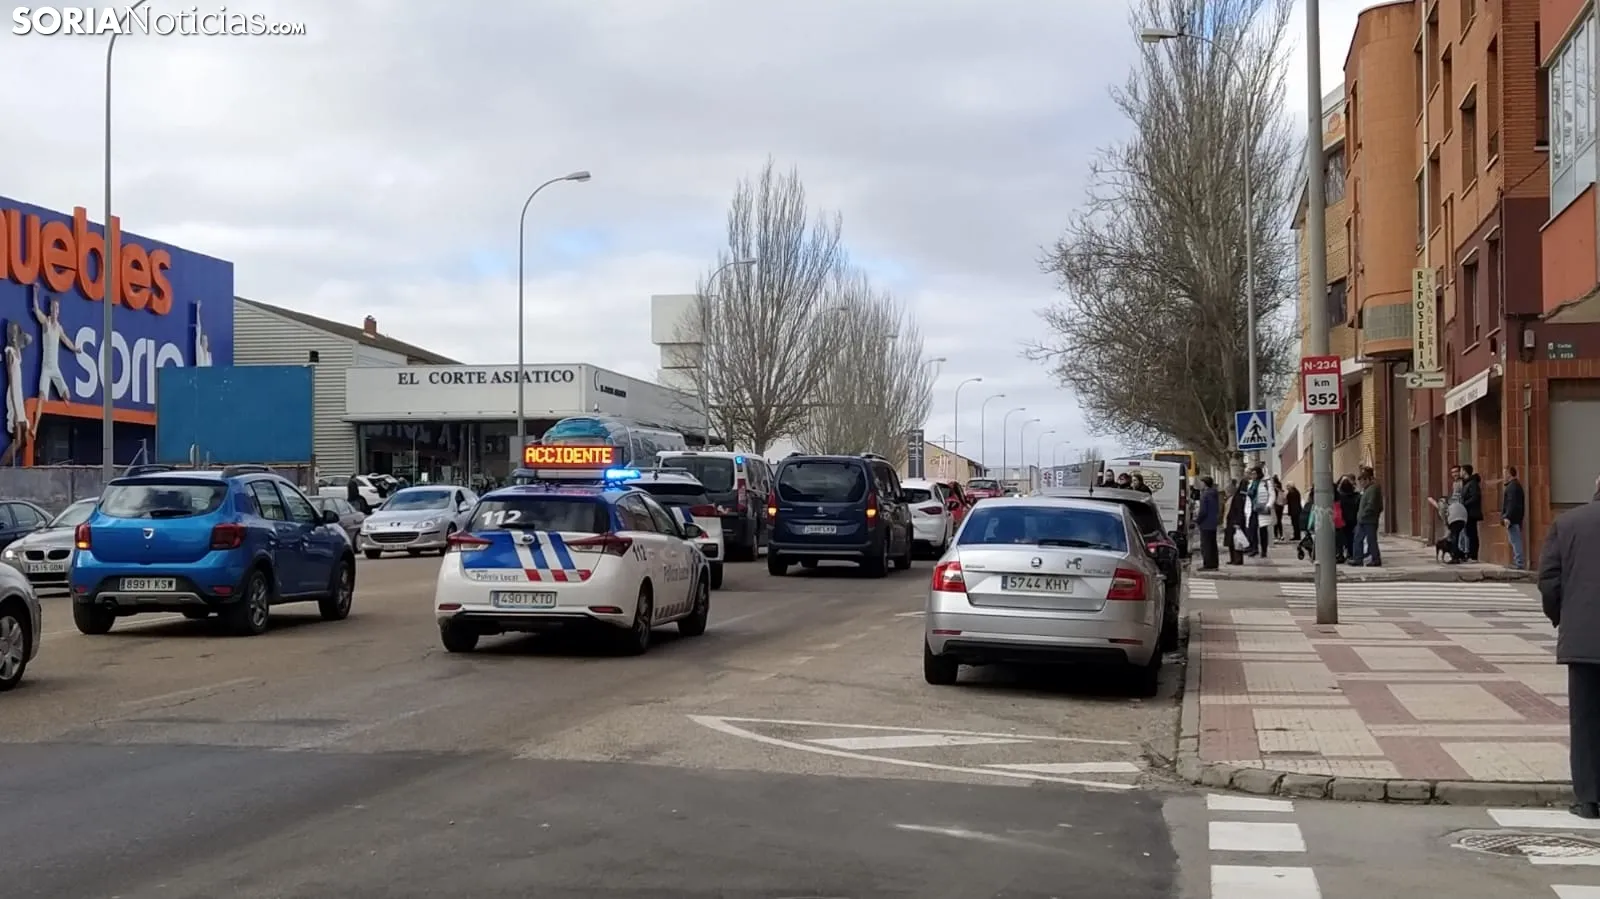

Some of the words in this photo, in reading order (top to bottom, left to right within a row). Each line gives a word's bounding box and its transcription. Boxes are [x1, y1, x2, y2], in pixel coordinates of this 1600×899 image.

[1416, 271, 1425, 370] REPOSTERIA
[1426, 275, 1434, 368] PANADERIA
[1304, 360, 1338, 370] N-234
[398, 372, 420, 385] EL
[428, 371, 487, 384] CORTE
[490, 369, 574, 384] ASIATICO
[1314, 378, 1330, 387] km
[1308, 392, 1338, 406] 352
[525, 447, 613, 463] ACCIDENTE
[481, 509, 521, 526] 112
[632, 544, 647, 562] 112
[126, 579, 151, 590] 8991
[1010, 575, 1041, 589] 5744
[1045, 577, 1070, 591] KHY
[501, 594, 528, 604] 4901
